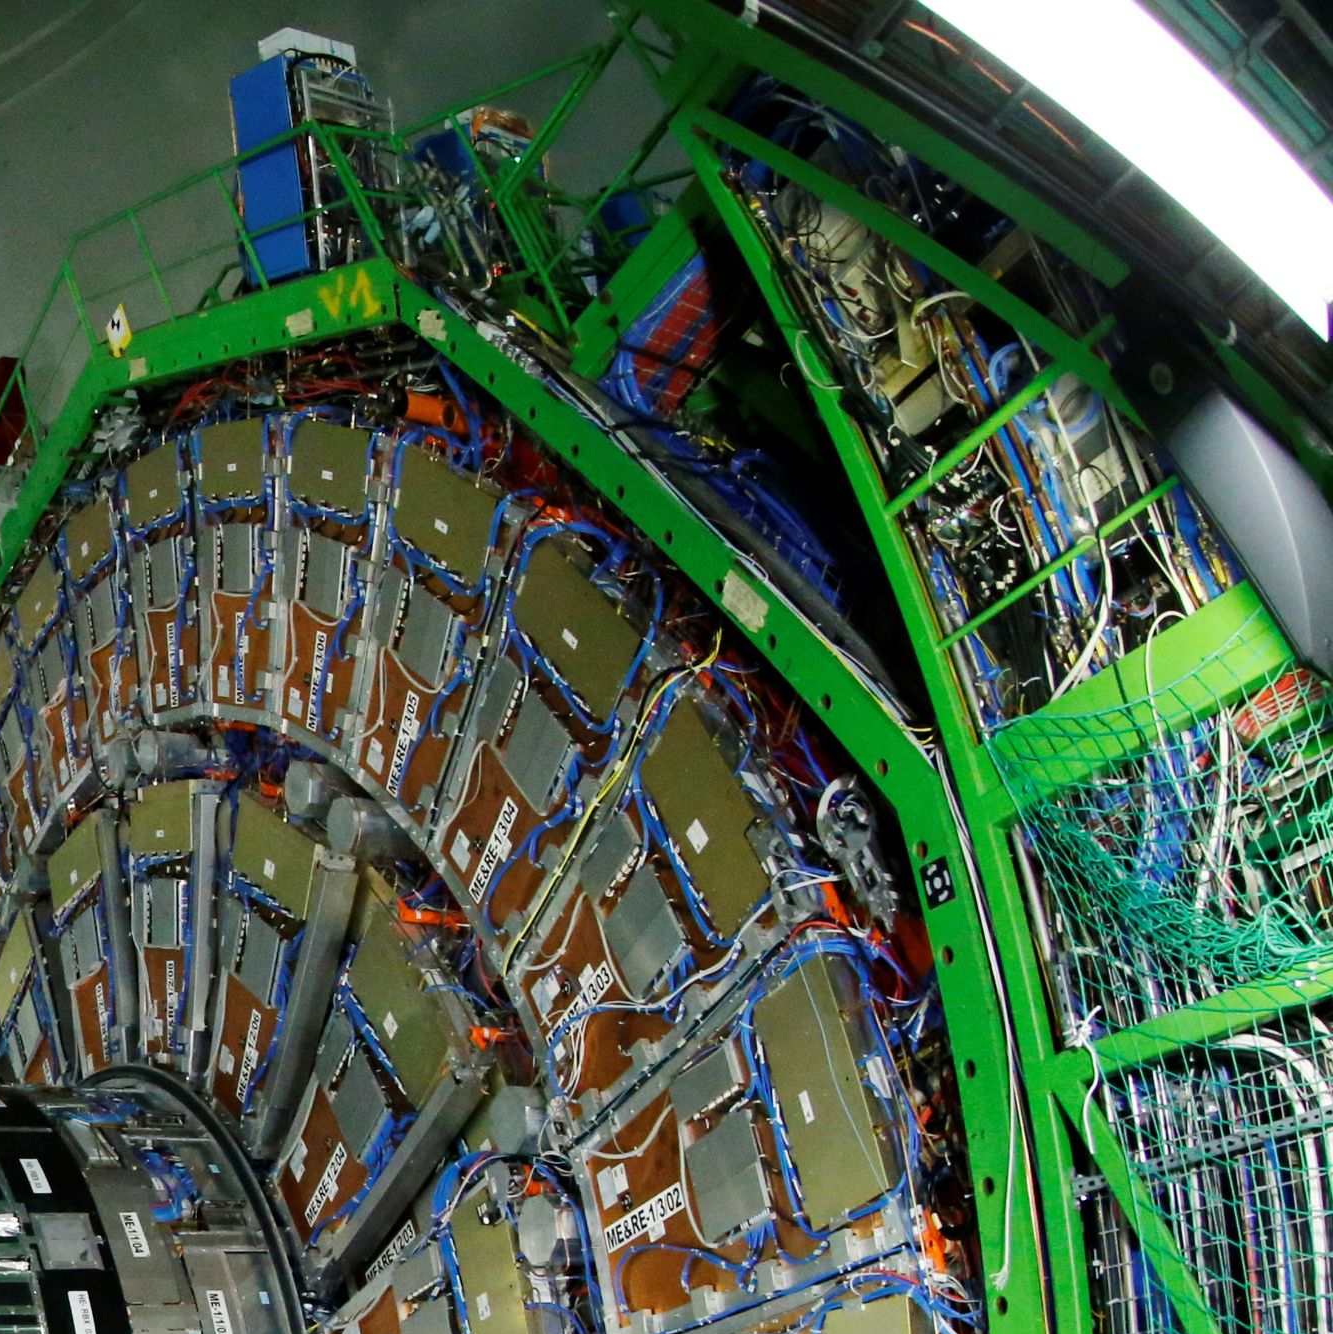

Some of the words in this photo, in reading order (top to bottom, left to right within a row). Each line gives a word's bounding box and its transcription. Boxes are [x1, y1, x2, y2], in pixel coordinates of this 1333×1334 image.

[388, 695, 418, 798] ME&RE-1/3/05
[471, 801, 517, 901] ME&RE-1/3/04
[237, 1013, 260, 1101] ME&RE-1/2/06
[306, 1147, 345, 1222] ME&RE-1/2/04
[606, 1186, 682, 1250] ME&RE-1/3/02
[121, 1214, 144, 1254] ME-1/1/04
[367, 1223, 414, 1282] ME&RE-1/2/03
